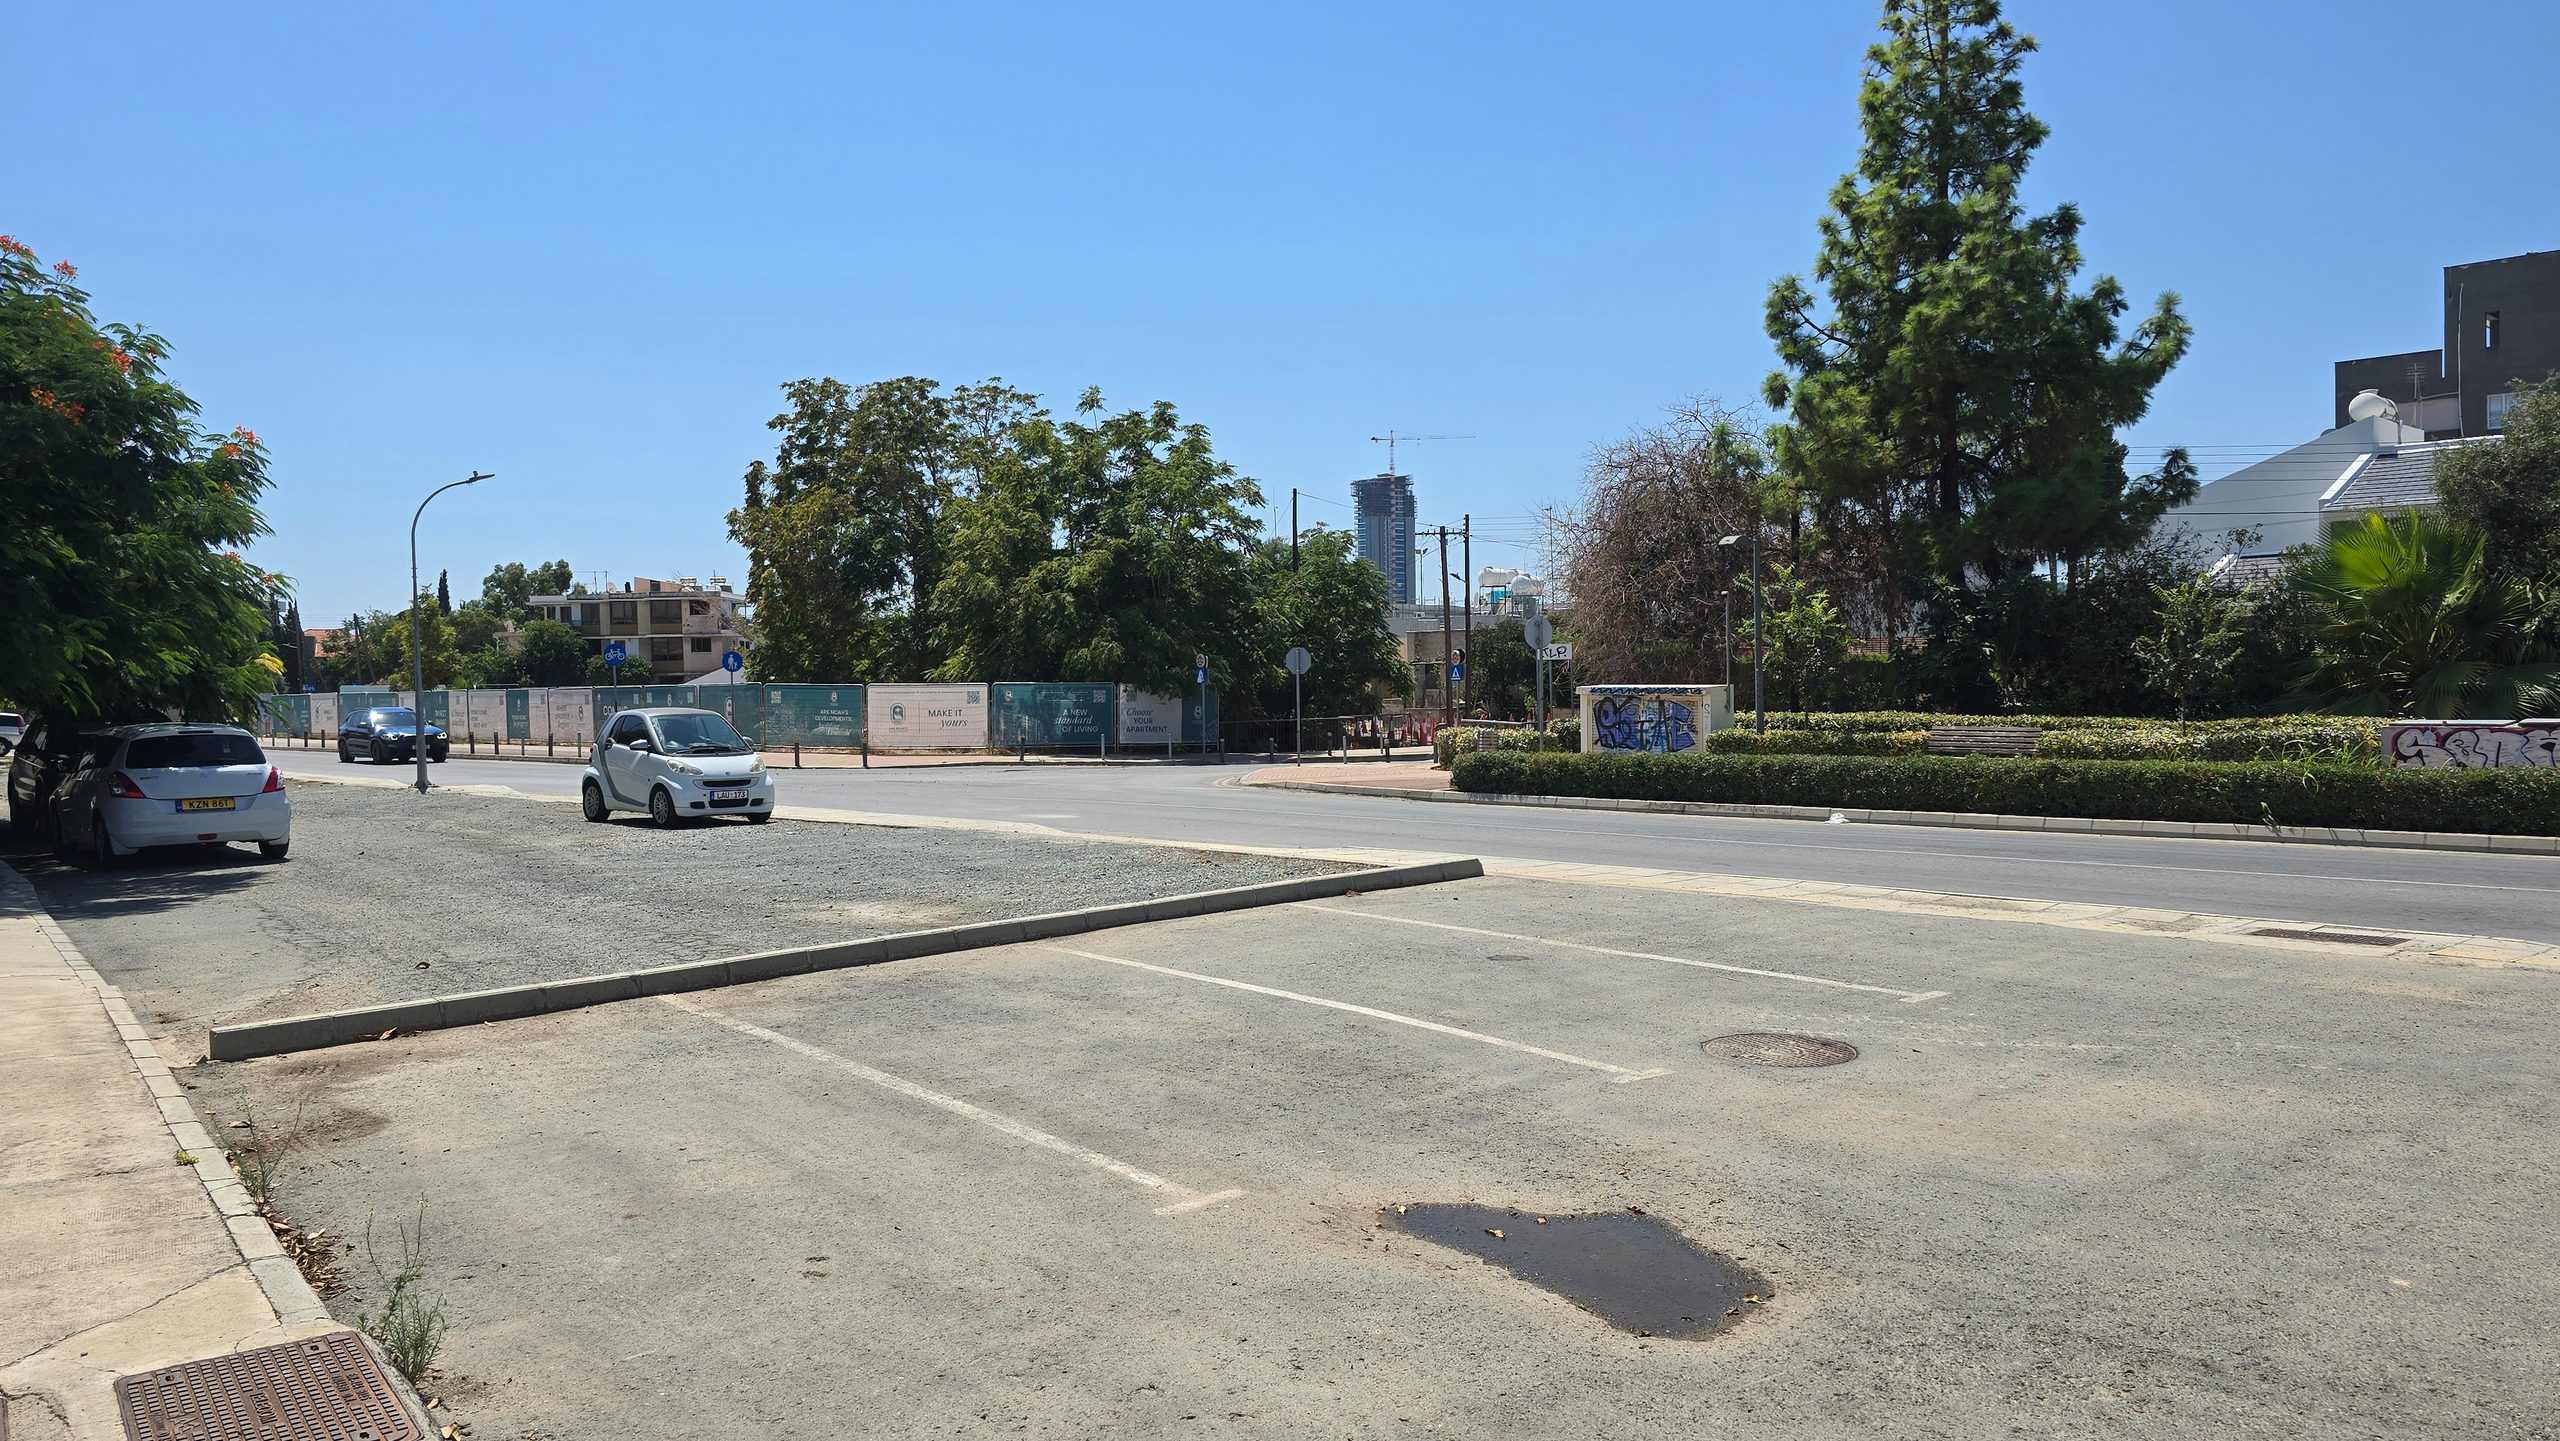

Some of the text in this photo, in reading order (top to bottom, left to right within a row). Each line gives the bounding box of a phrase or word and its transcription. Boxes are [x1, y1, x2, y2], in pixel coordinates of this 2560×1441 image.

[928, 709, 963, 717] MAKE IT
[1126, 707, 1154, 717] Choose
[1053, 715, 1094, 725] standard
[1133, 717, 1154, 725] YOUR
[939, 719, 969, 730] yours
[1074, 725, 1099, 733] LIVING
[1126, 725, 1168, 733] APARTMENT
[189, 801, 209, 809] KZN
